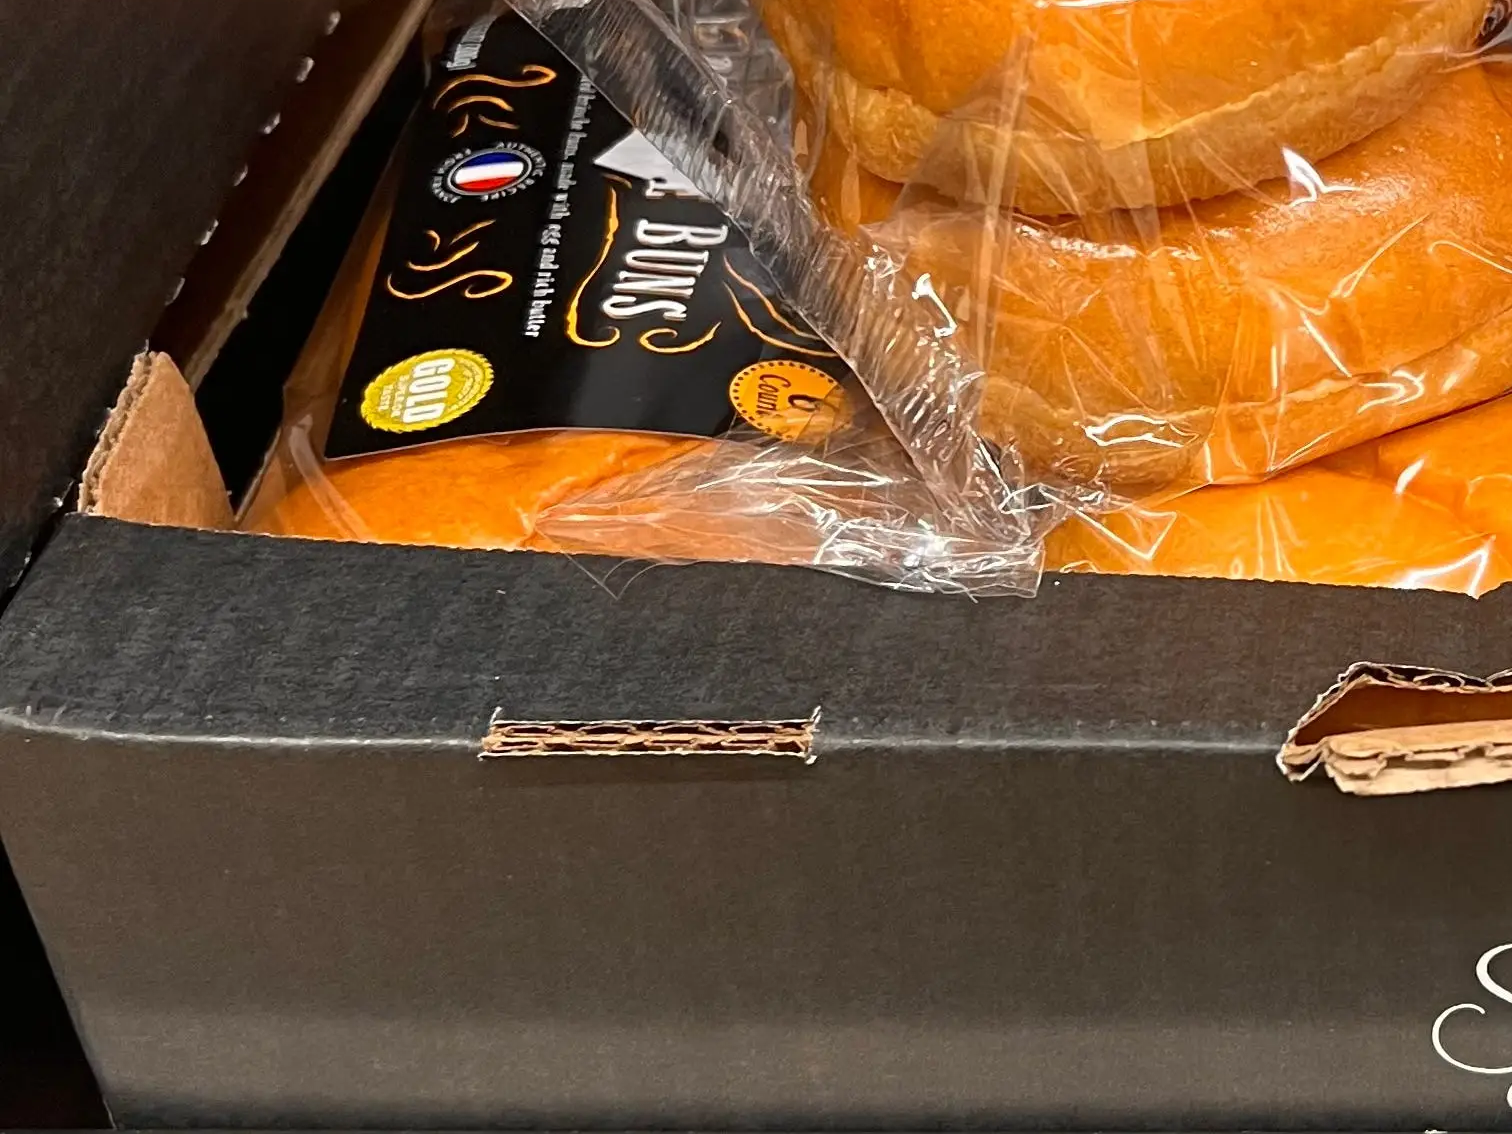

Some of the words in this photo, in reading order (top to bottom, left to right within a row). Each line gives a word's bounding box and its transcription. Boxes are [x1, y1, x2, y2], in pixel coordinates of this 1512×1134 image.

[540, 223, 561, 245] egg
[539, 248, 560, 270] and
[602, 218, 728, 321] BUNS
[533, 272, 555, 297] rich
[524, 299, 553, 338] butter
[401, 357, 456, 423] GOLD
[756, 374, 792, 417] Count
